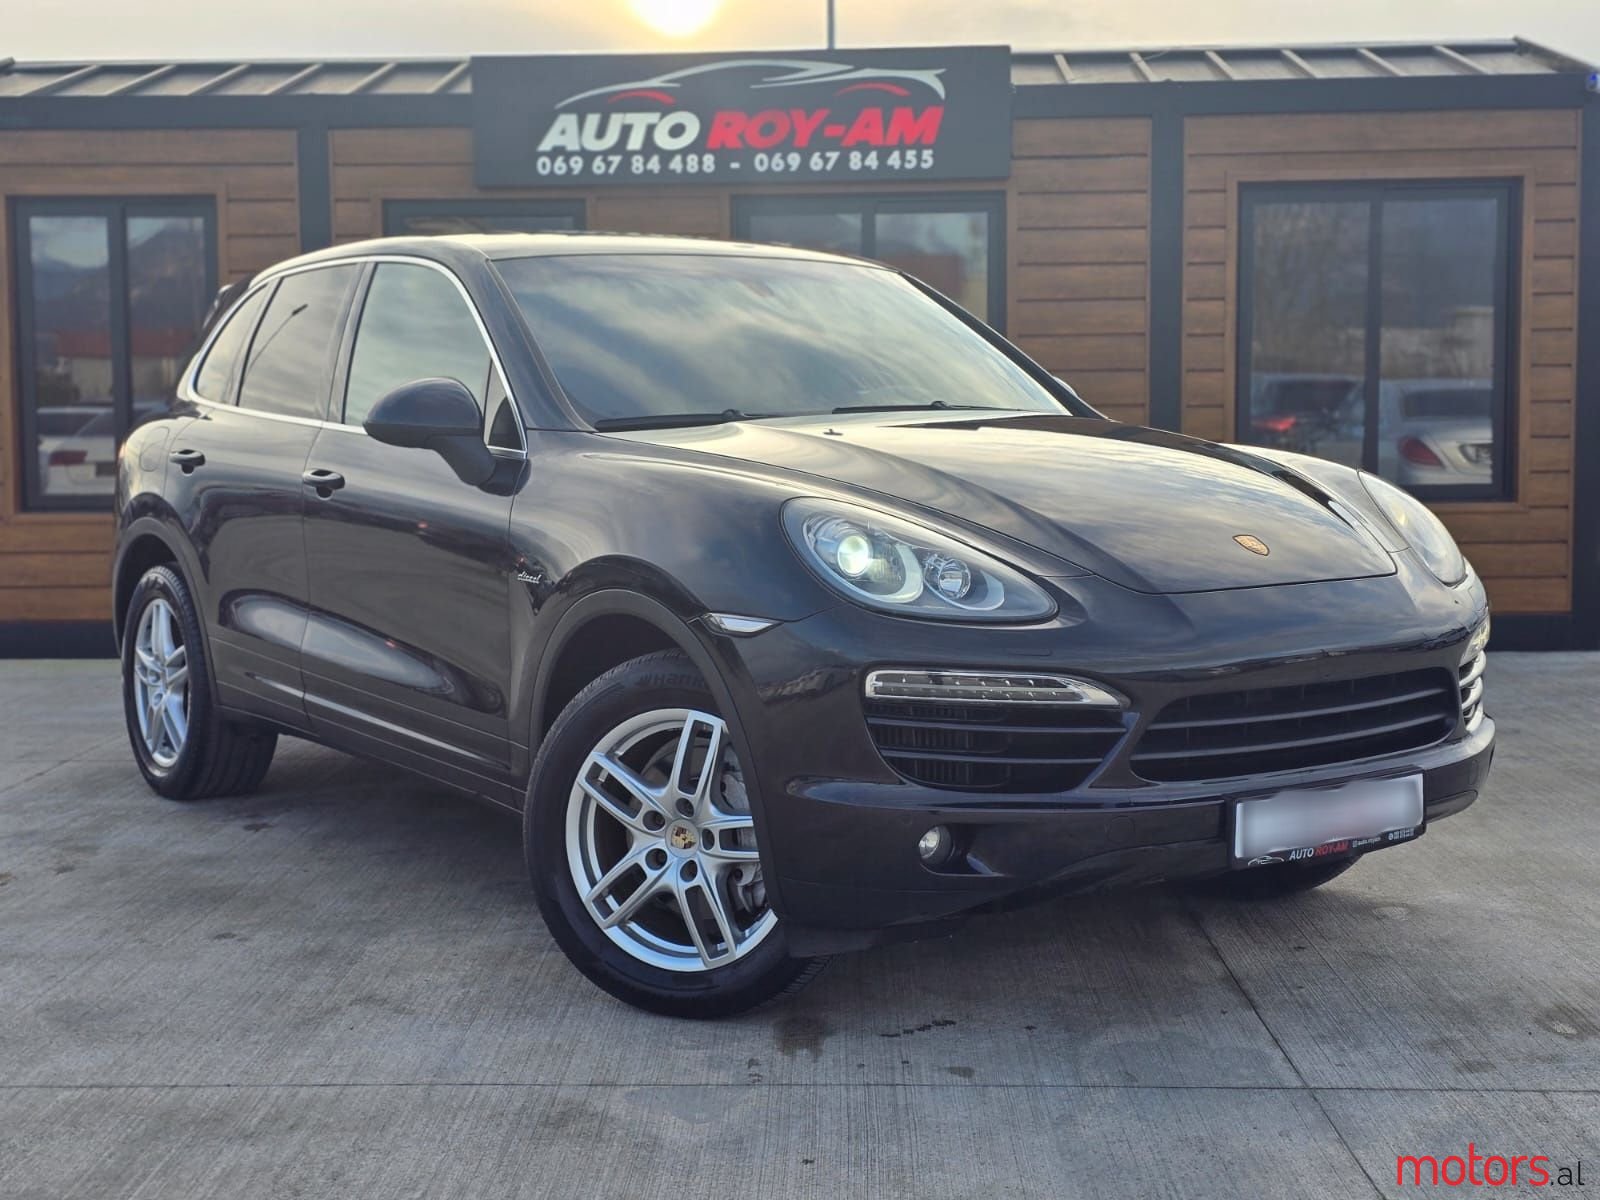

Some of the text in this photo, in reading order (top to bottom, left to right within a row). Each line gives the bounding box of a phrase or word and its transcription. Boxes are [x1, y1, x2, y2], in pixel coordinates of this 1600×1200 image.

[537, 105, 944, 151] AUTO ROY-AM
[536, 155, 584, 176] 069
[592, 155, 622, 175] 67
[631, 154, 661, 174] 84
[669, 153, 716, 173] 488
[754, 152, 801, 172] 069
[809, 151, 840, 171] 67
[849, 150, 879, 170] 84
[887, 149, 934, 169] 455
[1289, 847, 1314, 861] AUTO
